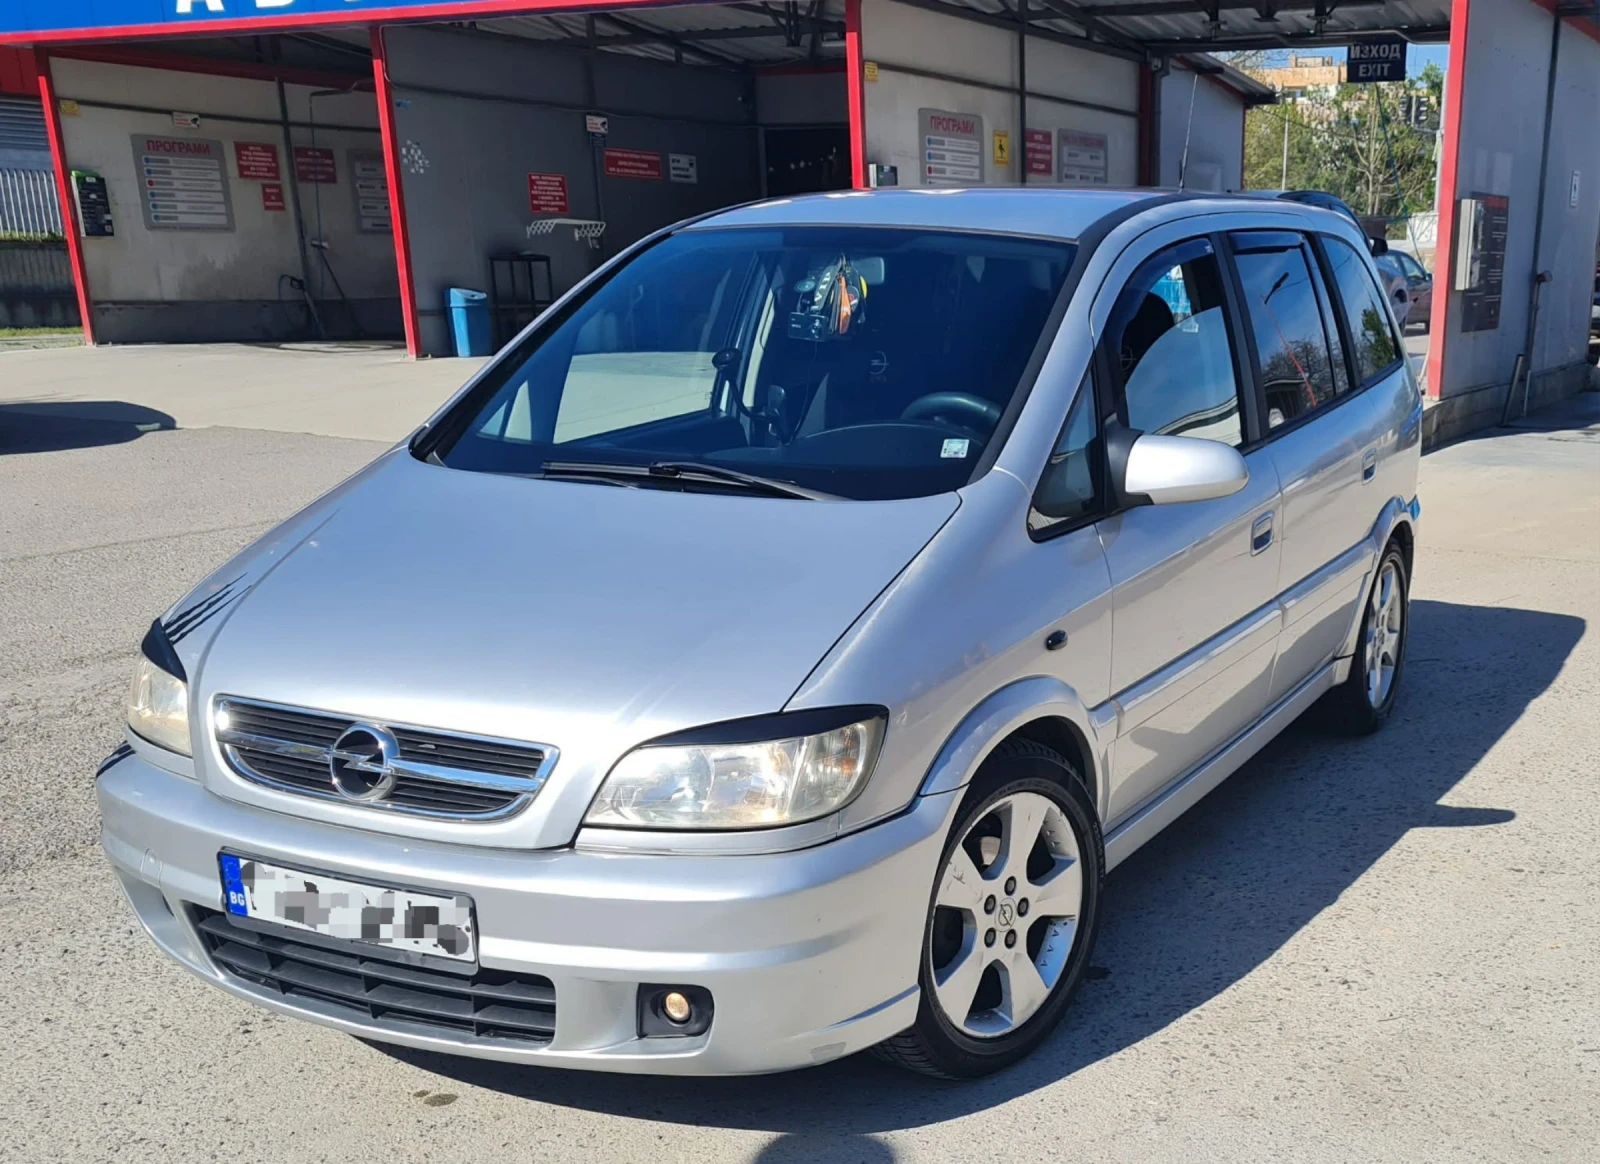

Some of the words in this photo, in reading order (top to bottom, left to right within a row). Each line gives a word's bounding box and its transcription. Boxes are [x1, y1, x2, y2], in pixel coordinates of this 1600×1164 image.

[1350, 44, 1401, 60] ИЗХОД
[1359, 63, 1391, 77] EXIT
[930, 115, 975, 136] ПРОГРАМИ
[146, 140, 211, 155] ПРОГРАМИ
[230, 891, 245, 906] BG
